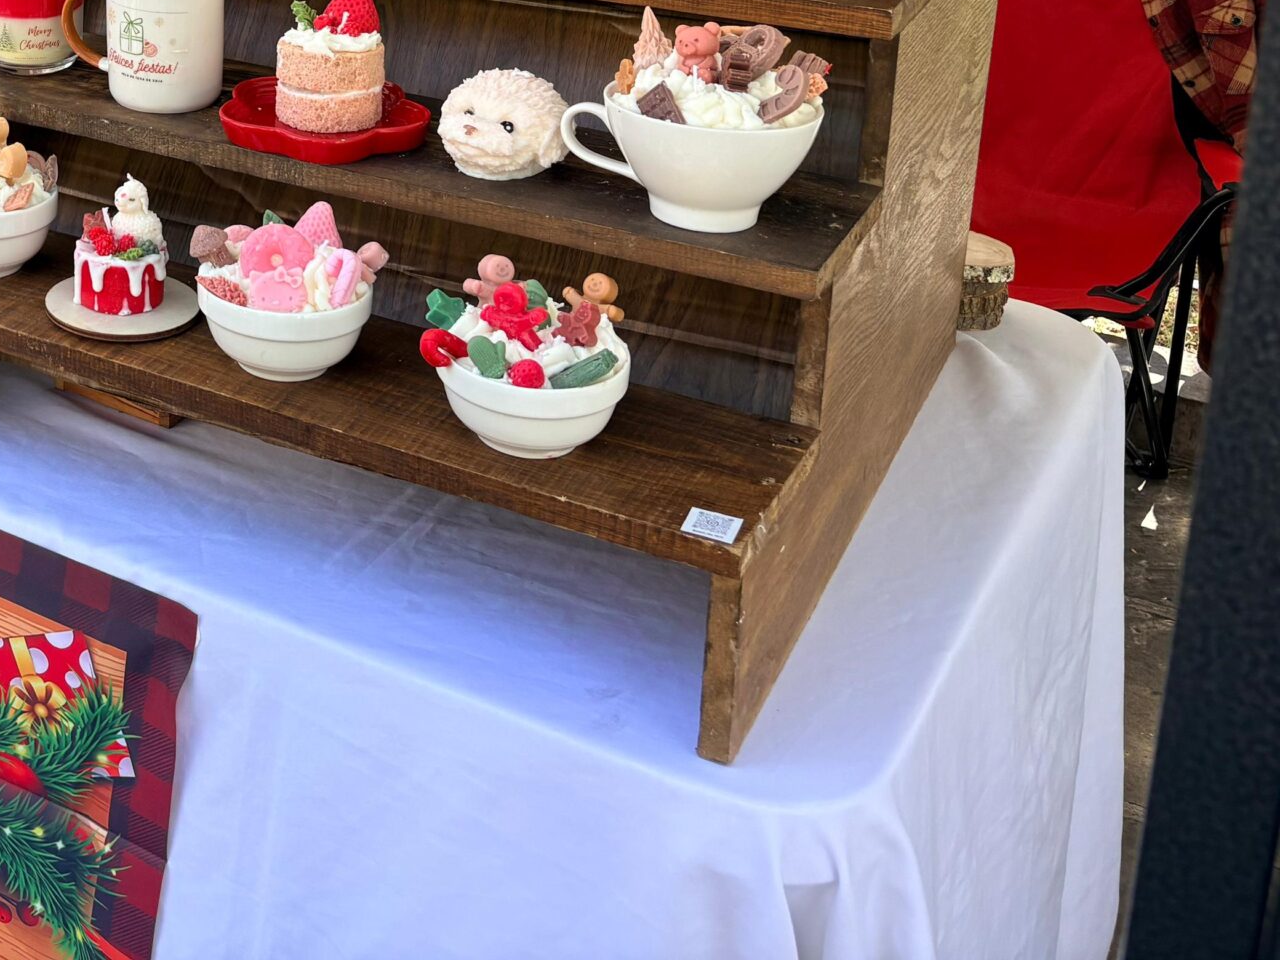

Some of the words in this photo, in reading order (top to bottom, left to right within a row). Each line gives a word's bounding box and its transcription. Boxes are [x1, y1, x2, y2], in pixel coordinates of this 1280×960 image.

[27, 26, 53, 37] Merry
[19, 39, 61, 51] Christmas
[133, 58, 179, 75] fiestas!
